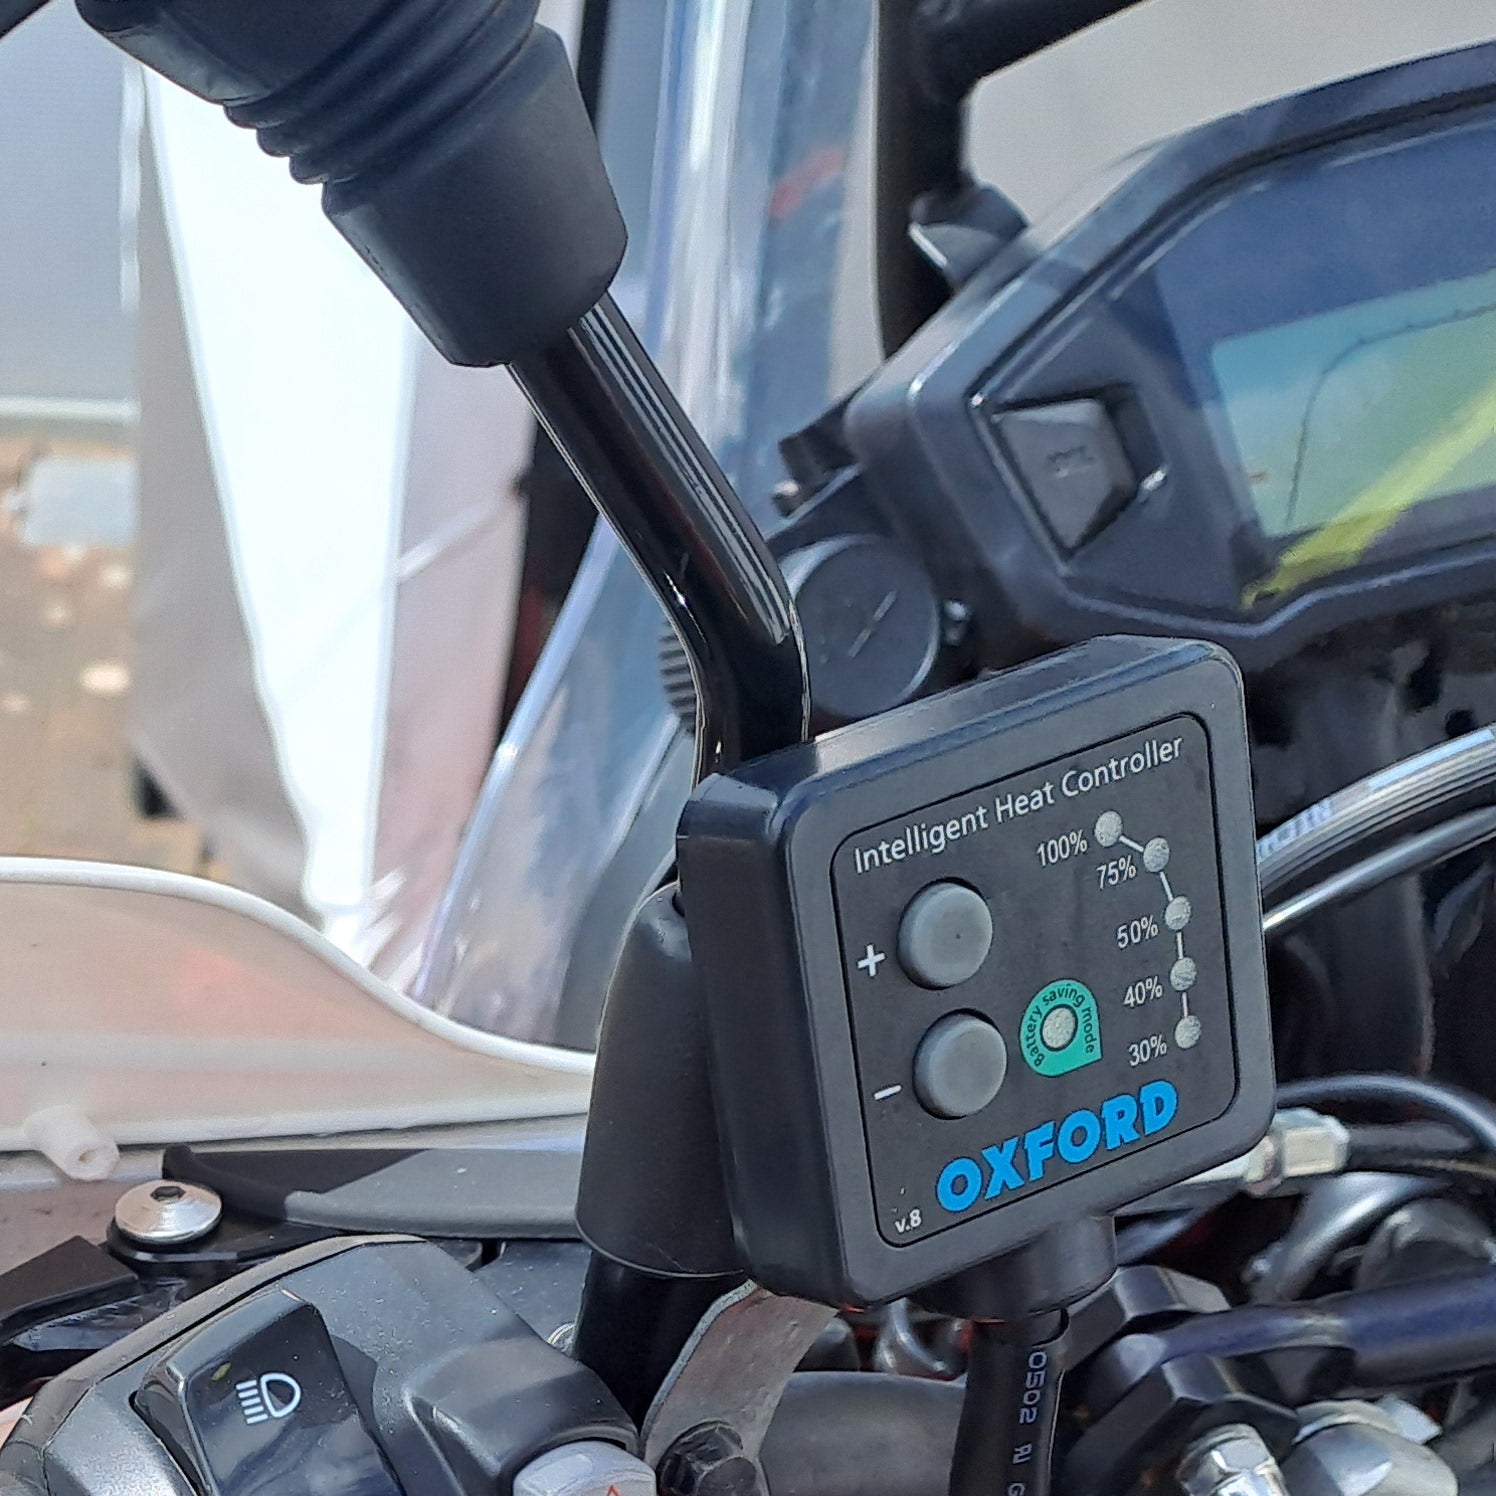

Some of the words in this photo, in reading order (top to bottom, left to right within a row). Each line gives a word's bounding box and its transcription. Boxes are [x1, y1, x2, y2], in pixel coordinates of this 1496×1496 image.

[855, 804, 988, 874] Intelligent
[995, 781, 1055, 823] Heat
[1062, 737, 1183, 797] Controller
[1036, 829, 1088, 867] 100%
[1096, 855, 1137, 889] 75%
[1116, 915, 1159, 950] 50%
[1123, 976, 1163, 1008] 40%
[1025, 1004, 1045, 1067] Battery
[1042, 983, 1085, 1008] saving
[1081, 1006, 1098, 1054] mode
[1128, 1034, 1167, 1067] 30%
[936, 1079, 1179, 1213] OXFORD
[894, 1208, 923, 1234] v.8
